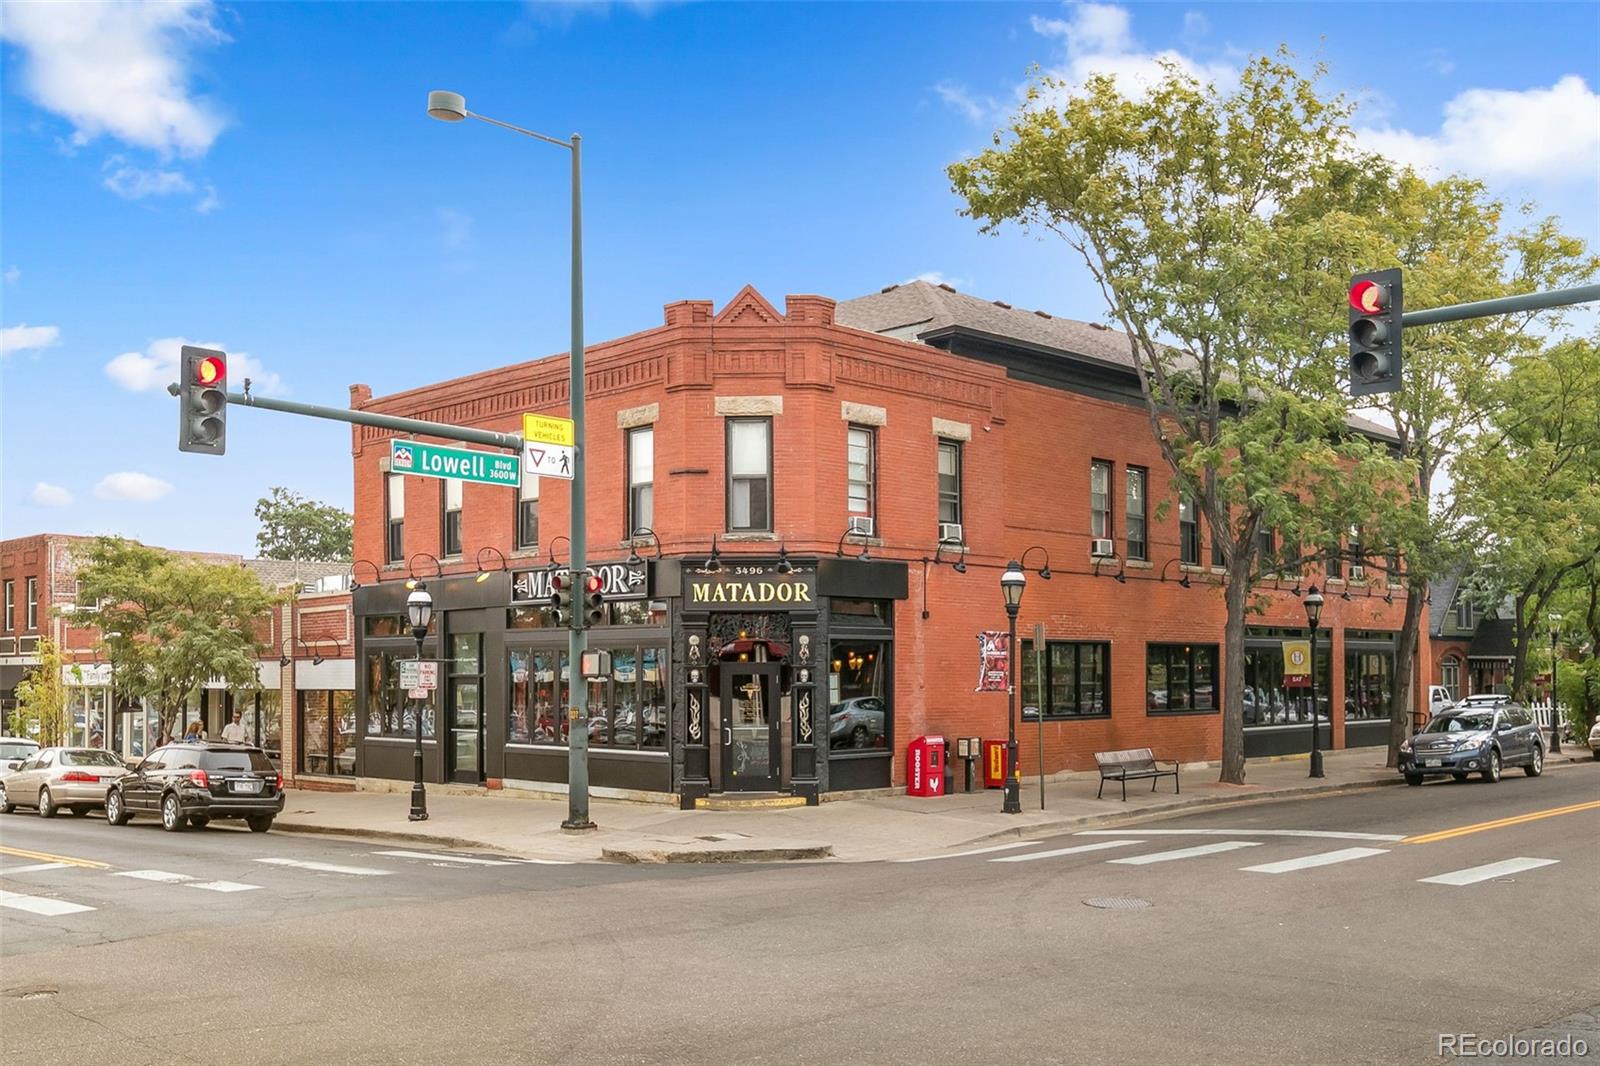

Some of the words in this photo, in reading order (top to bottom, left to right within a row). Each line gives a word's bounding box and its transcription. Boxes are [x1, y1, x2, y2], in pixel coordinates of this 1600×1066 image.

[536, 420, 564, 431] TURNING
[534, 431, 566, 442] VEHICLES
[421, 450, 485, 478] Lowell
[494, 460, 512, 471] Blvd
[547, 456, 556, 464] TO
[735, 566, 763, 575] 3496
[527, 565, 631, 598] MAOR
[692, 582, 812, 603] MATADOR
